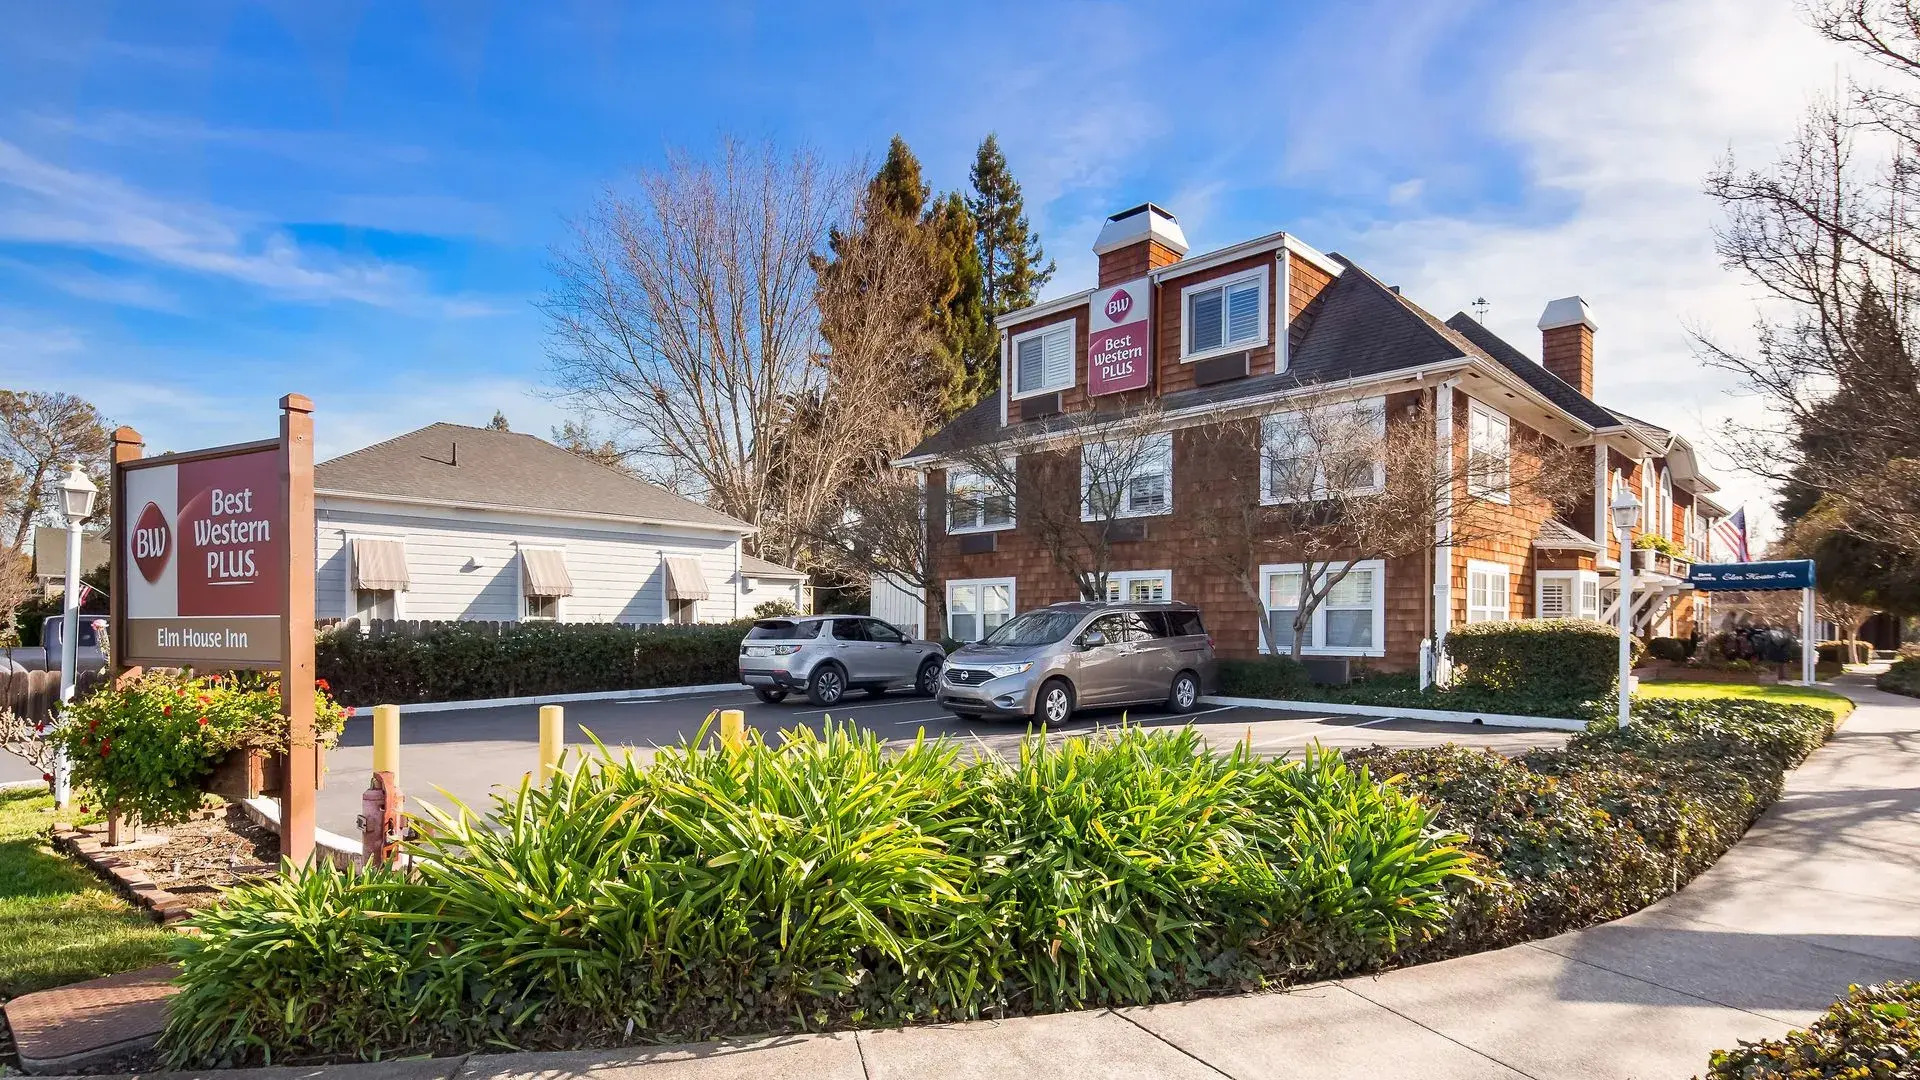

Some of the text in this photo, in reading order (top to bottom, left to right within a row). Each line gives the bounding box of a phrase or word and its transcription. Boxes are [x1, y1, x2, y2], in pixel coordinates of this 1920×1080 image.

[1108, 298, 1129, 315] BW
[1105, 335, 1131, 350] Best
[1094, 346, 1142, 366] Western
[211, 488, 253, 516] Best
[137, 526, 166, 559] BW
[194, 519, 270, 546] Western
[1722, 572, 1743, 580] Elm
[1745, 572, 1776, 580] House
[157, 628, 248, 648] Elm House Inn
